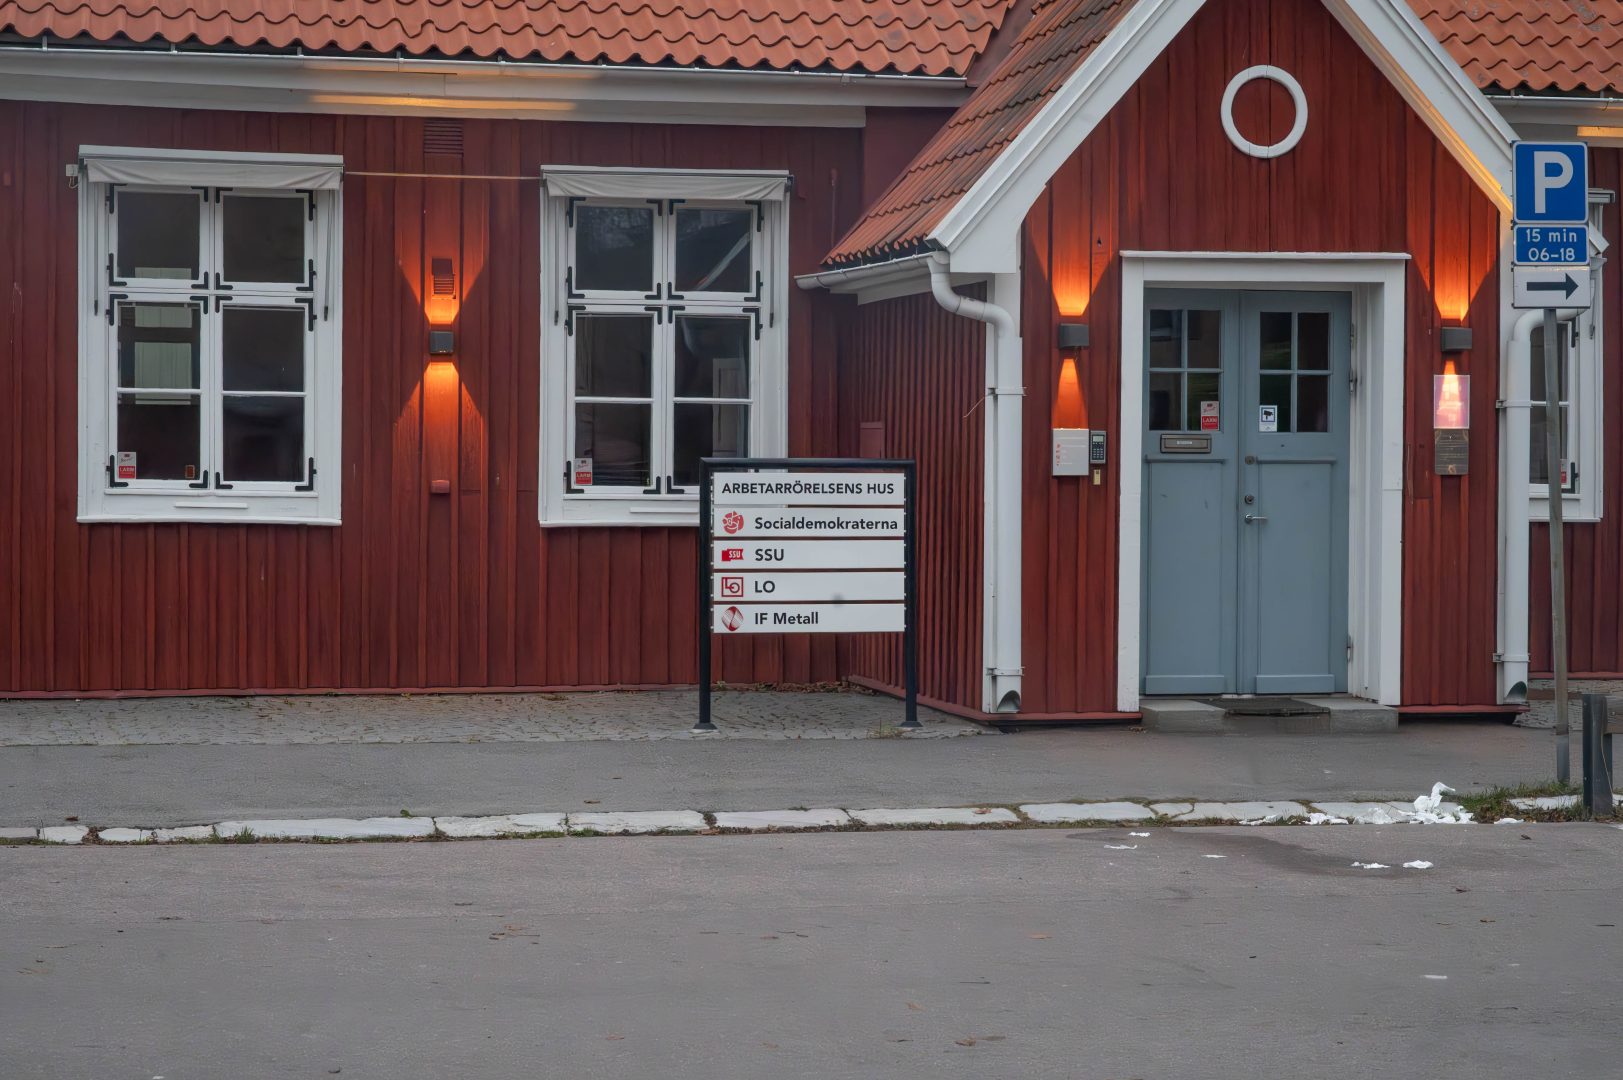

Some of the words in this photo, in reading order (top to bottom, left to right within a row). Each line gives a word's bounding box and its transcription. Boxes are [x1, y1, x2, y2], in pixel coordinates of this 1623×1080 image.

[1533, 150, 1574, 214] P
[1526, 229, 1541, 242] 15
[1548, 229, 1577, 242] min
[721, 480, 863, 494] ARBETARRÖRELSENS
[867, 483, 894, 494] HUS
[754, 517, 898, 530] Socialdemokraterna
[729, 551, 741, 559] SSU
[755, 549, 785, 561] SSU
[754, 580, 776, 593] LO
[755, 612, 768, 625] IF
[773, 611, 819, 625] Metall
